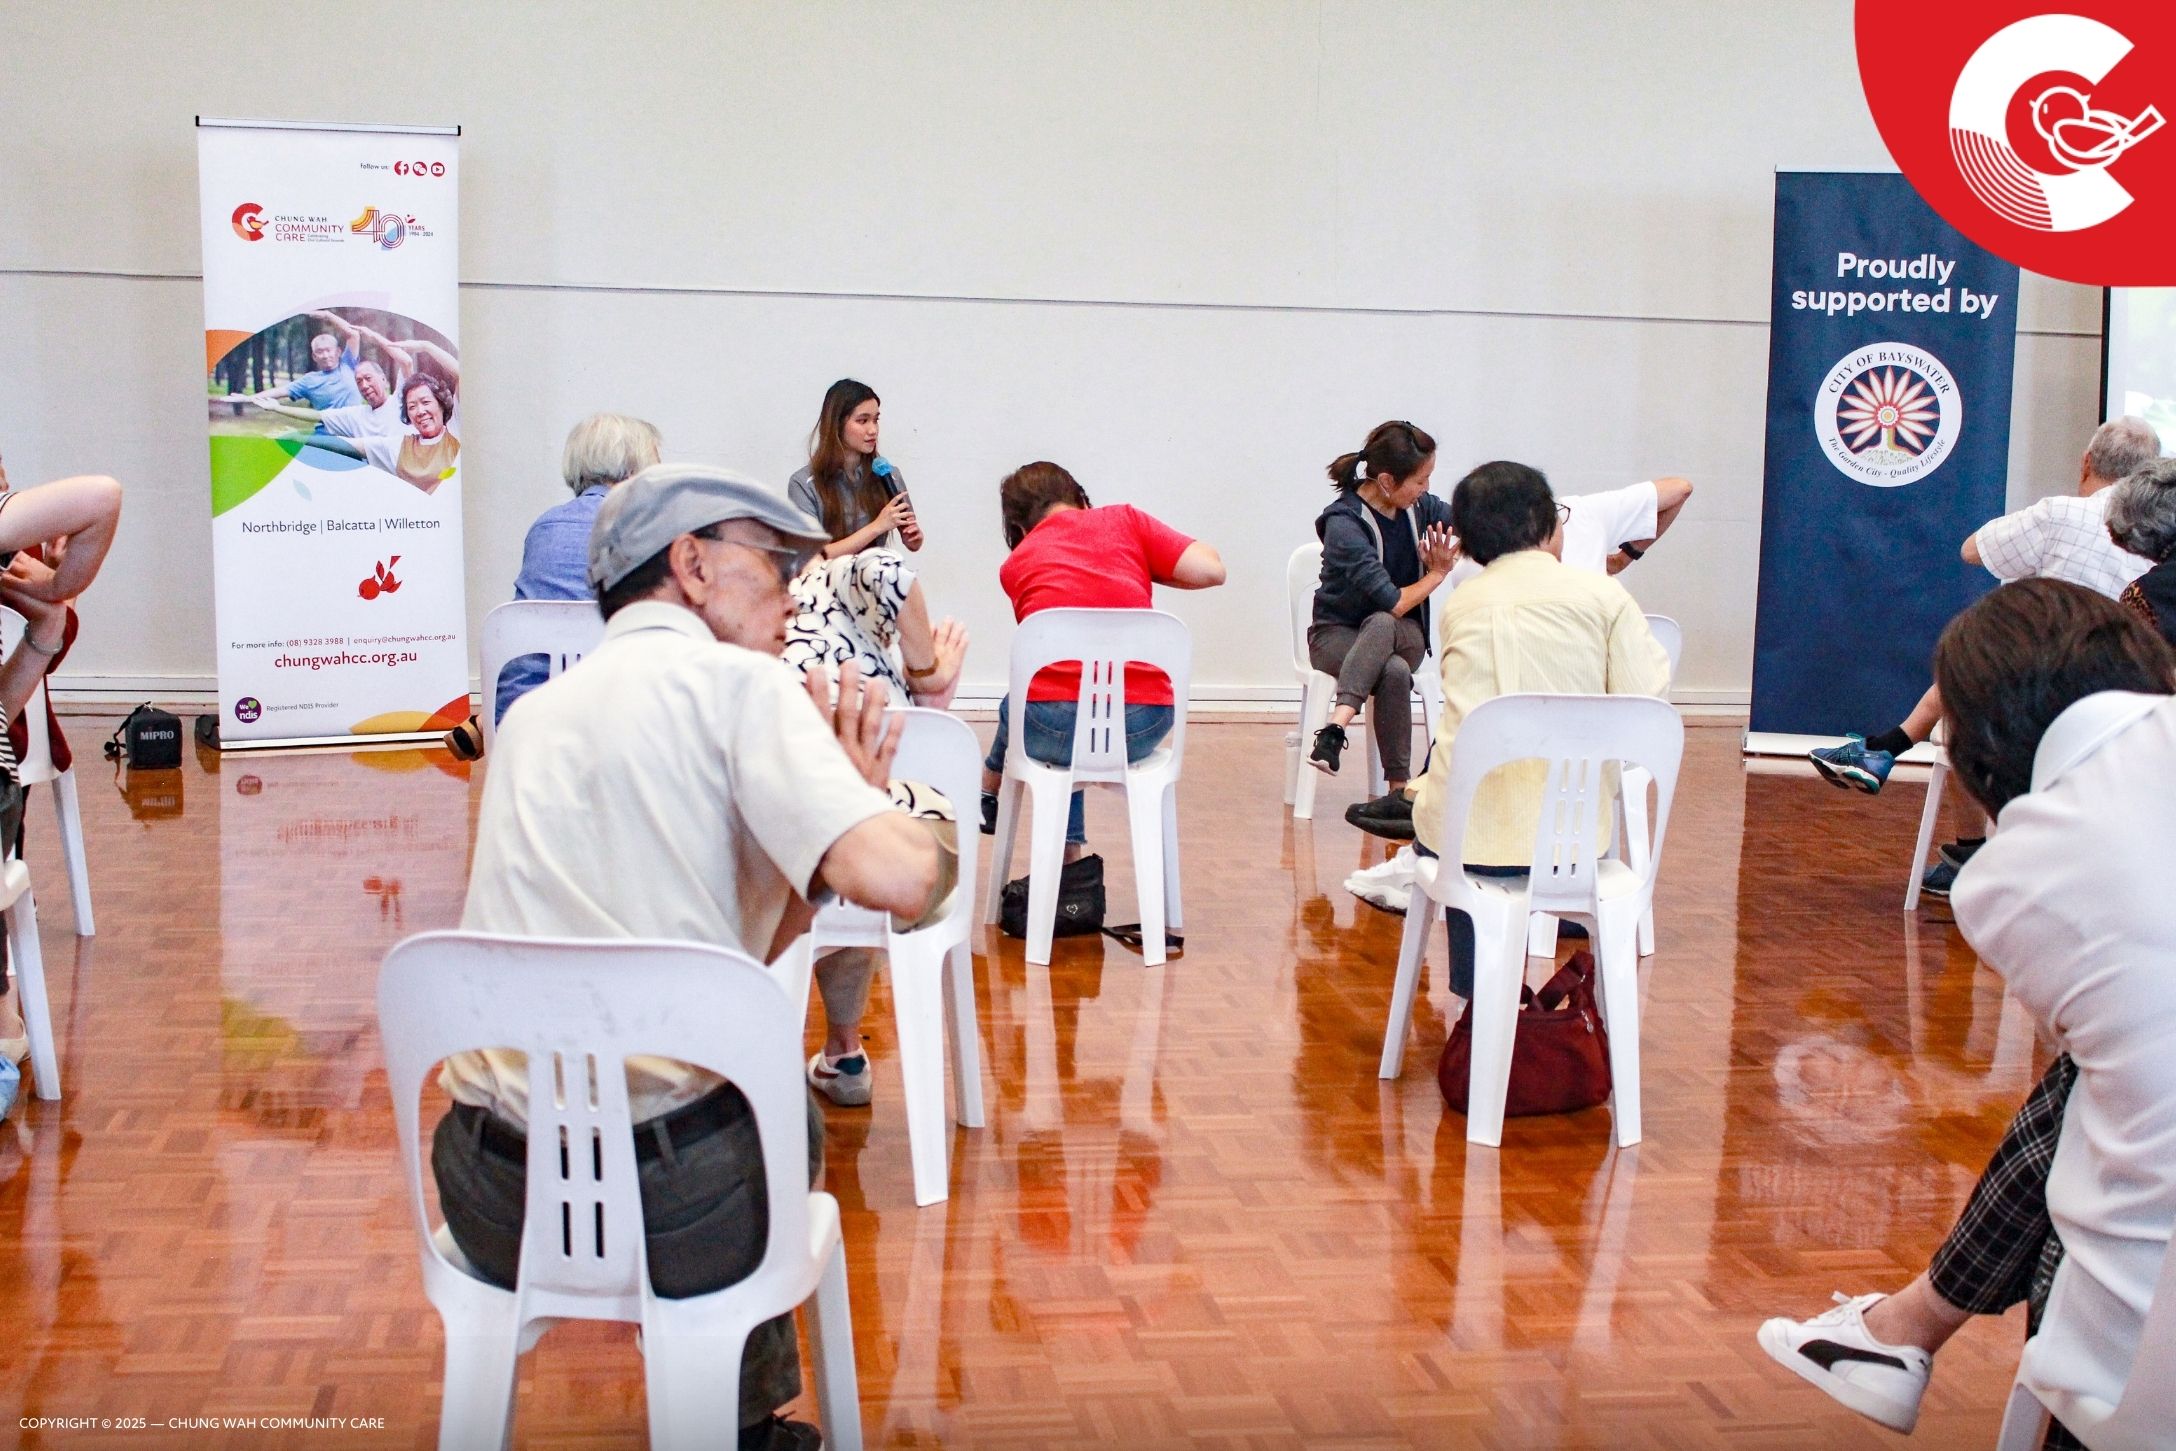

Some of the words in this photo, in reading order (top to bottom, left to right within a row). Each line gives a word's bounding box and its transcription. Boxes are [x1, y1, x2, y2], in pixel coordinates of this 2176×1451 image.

[275, 224, 344, 233] COMMUNITY
[276, 233, 306, 242] CARE
[1836, 252, 1956, 286] Proudly
[1791, 288, 1951, 316] supported
[1960, 288, 1999, 319] by
[1828, 364, 1854, 394] CITY
[1856, 354, 1874, 367] OF
[1879, 352, 1950, 394] BAYSWATER
[1828, 437, 1840, 452] The
[1838, 450, 1864, 472] Garden
[1866, 466, 1882, 478] City
[1890, 464, 1919, 478] Quality
[1920, 439, 1946, 467] Lifestyle
[242, 520, 317, 536] Northbridge
[326, 520, 376, 532] Balcatta
[384, 518, 441, 530] Willetton
[268, 640, 285, 648] info:
[286, 639, 302, 648] (08)
[353, 634, 456, 645] enquiry@chungwahcc.org.au
[274, 651, 418, 670] chungwahcc.org.au
[239, 711, 258, 720] ndis
[266, 704, 298, 712] Registered
[140, 730, 174, 740] MIPRO
